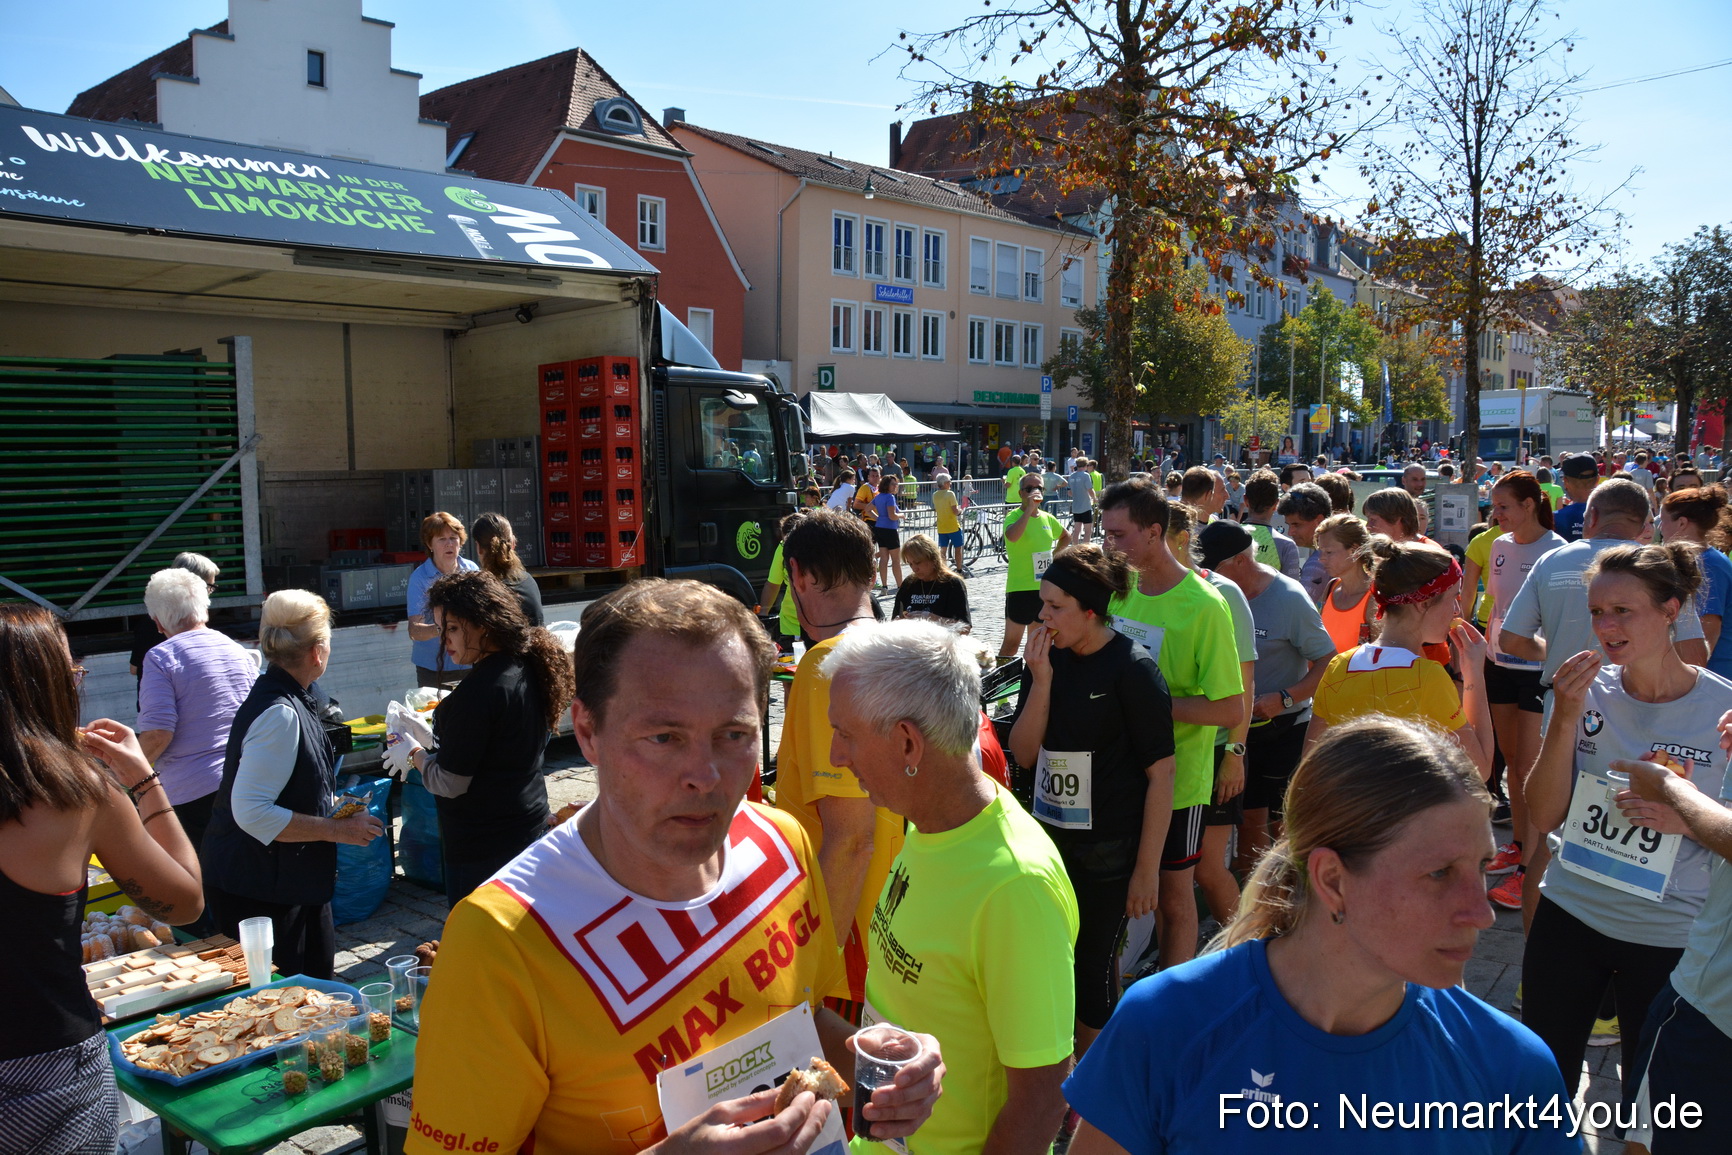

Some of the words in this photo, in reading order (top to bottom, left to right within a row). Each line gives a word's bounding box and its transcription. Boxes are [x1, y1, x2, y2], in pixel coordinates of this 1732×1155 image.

[20, 125, 331, 180] Willkommen
[141, 160, 434, 214] NEUMARKTER
[337, 174, 362, 186] IN
[365, 178, 409, 192] DER
[184, 188, 436, 235] LIMOKÜCHE
[820, 370, 833, 387] D
[973, 390, 1040, 405] DEICHMANN
[1122, 624, 1148, 639] BOCK
[1579, 739, 1598, 751] PARTL
[1651, 742, 1713, 764] BOCK
[1041, 767, 1080, 797] 2309
[1046, 806, 1062, 820] Anja
[1583, 837, 1605, 850] PARTL
[1605, 845, 1638, 862] Neumarkt
[633, 976, 745, 1086] MAX
[743, 900, 821, 993] BÖGL
[706, 1040, 775, 1092] BOCK
[708, 1084, 730, 1099] inspired
[738, 1072, 754, 1085] smart
[753, 1060, 777, 1077] concepts
